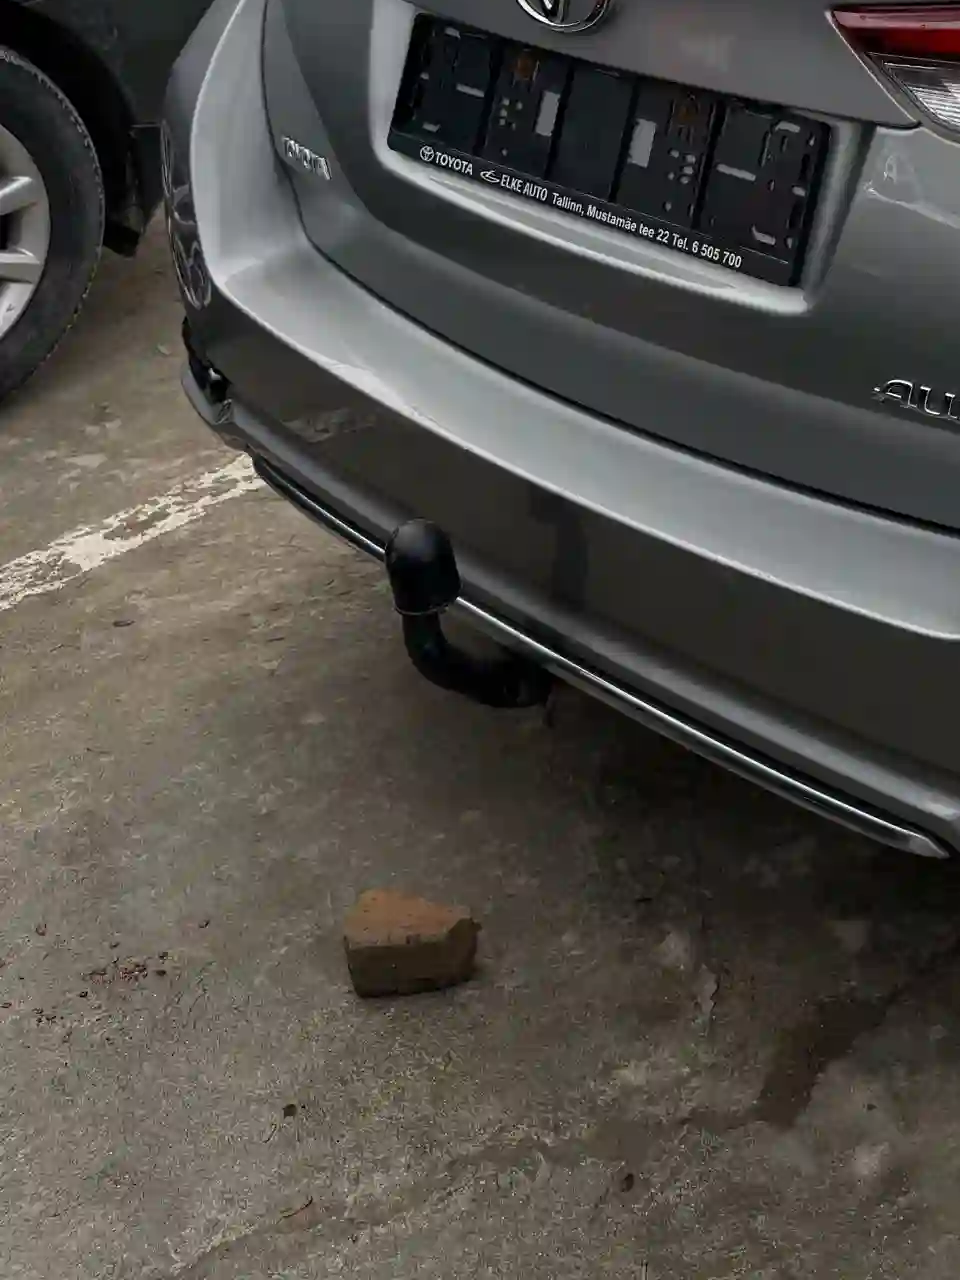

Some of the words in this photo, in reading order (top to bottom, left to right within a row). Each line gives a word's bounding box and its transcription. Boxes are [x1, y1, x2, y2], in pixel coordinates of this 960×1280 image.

[435, 151, 473, 176] TOYOTA
[500, 174, 523, 193] ELKE
[522, 182, 548, 202] AUTO
[552, 192, 584, 216] Tallinn,
[586, 204, 637, 232] Mustamäe
[639, 223, 655, 238] tee
[656, 228, 670, 243] 22
[672, 233, 689, 251] Tel.
[692, 240, 700, 253] 6
[700, 244, 721, 261] 505
[722, 251, 742, 268] 700
